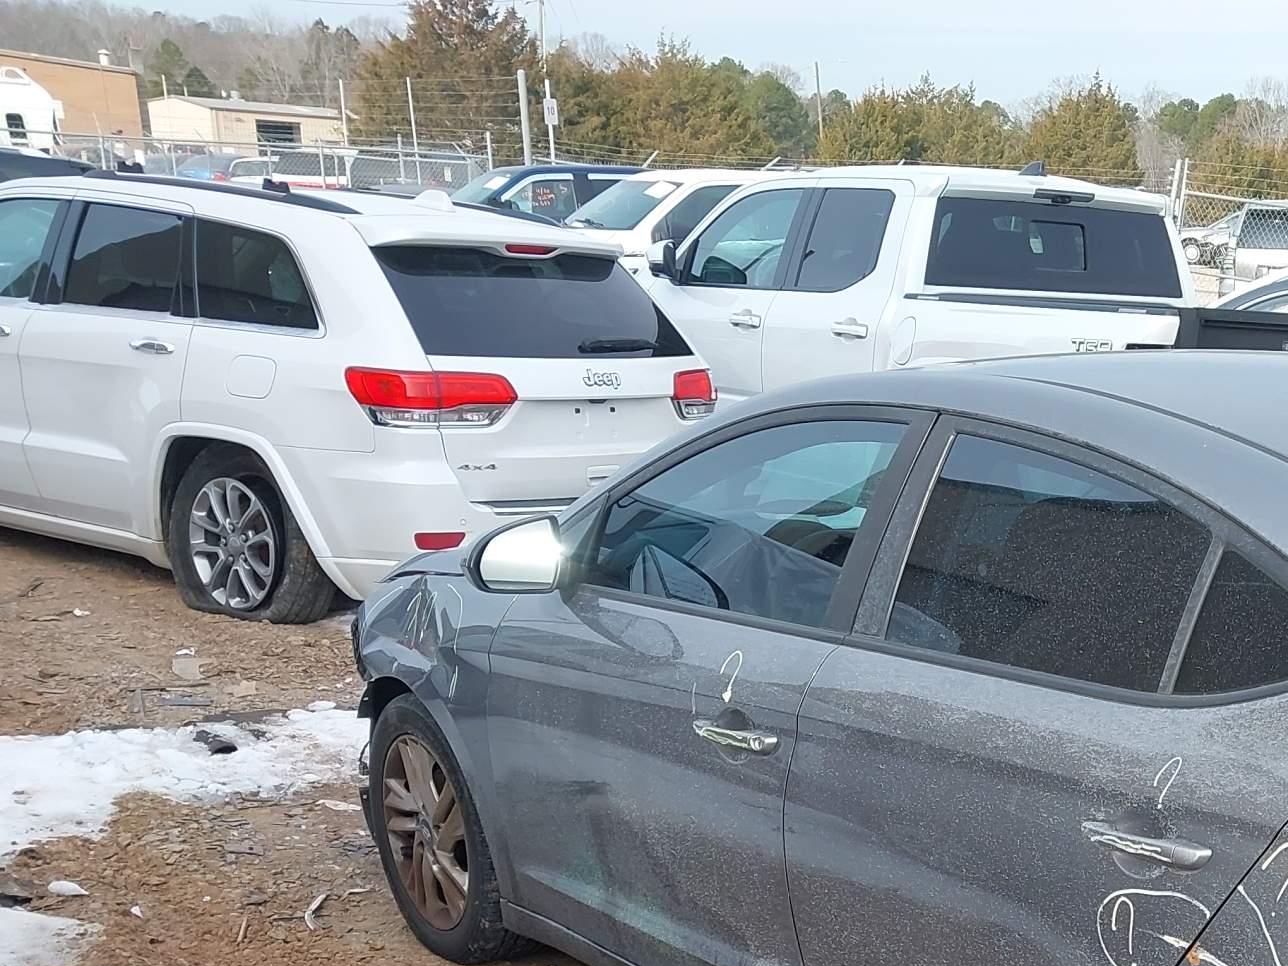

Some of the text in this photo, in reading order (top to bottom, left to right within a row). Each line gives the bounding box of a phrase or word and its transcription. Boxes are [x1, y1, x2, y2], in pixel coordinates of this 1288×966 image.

[547, 106, 555, 116] 10
[583, 369, 622, 389] Jeep
[457, 463, 498, 471] 4x4
